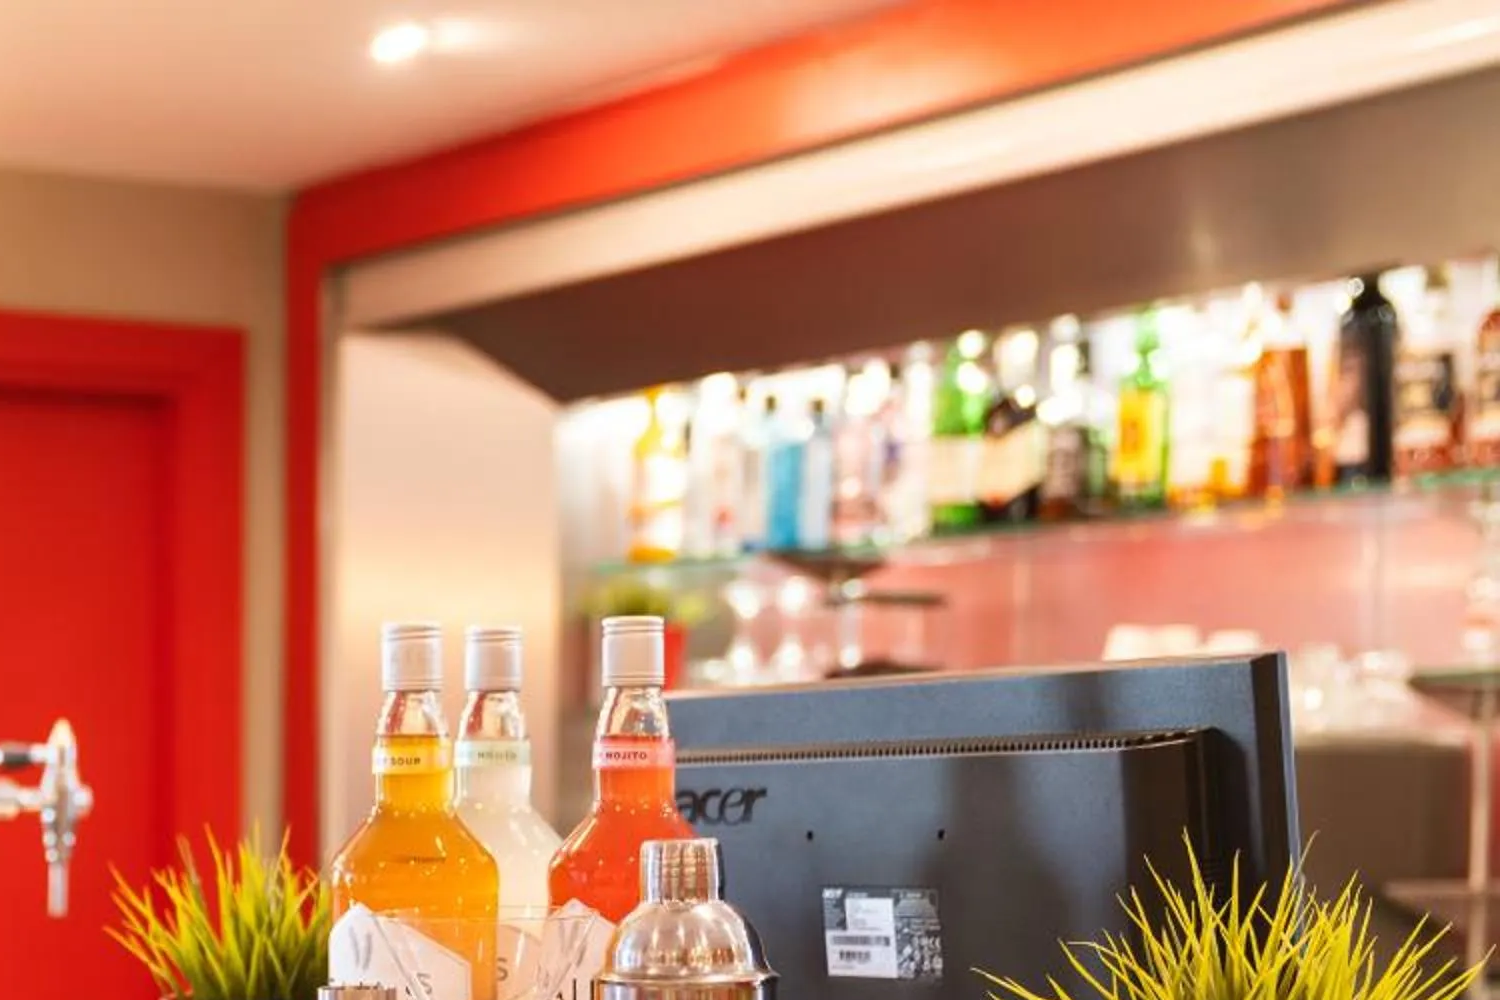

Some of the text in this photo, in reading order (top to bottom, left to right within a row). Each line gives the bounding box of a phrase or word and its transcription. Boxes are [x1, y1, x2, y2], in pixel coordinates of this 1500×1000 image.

[605, 751, 647, 760] MOJITO
[390, 756, 421, 766] SOUR
[675, 785, 768, 826] acer
